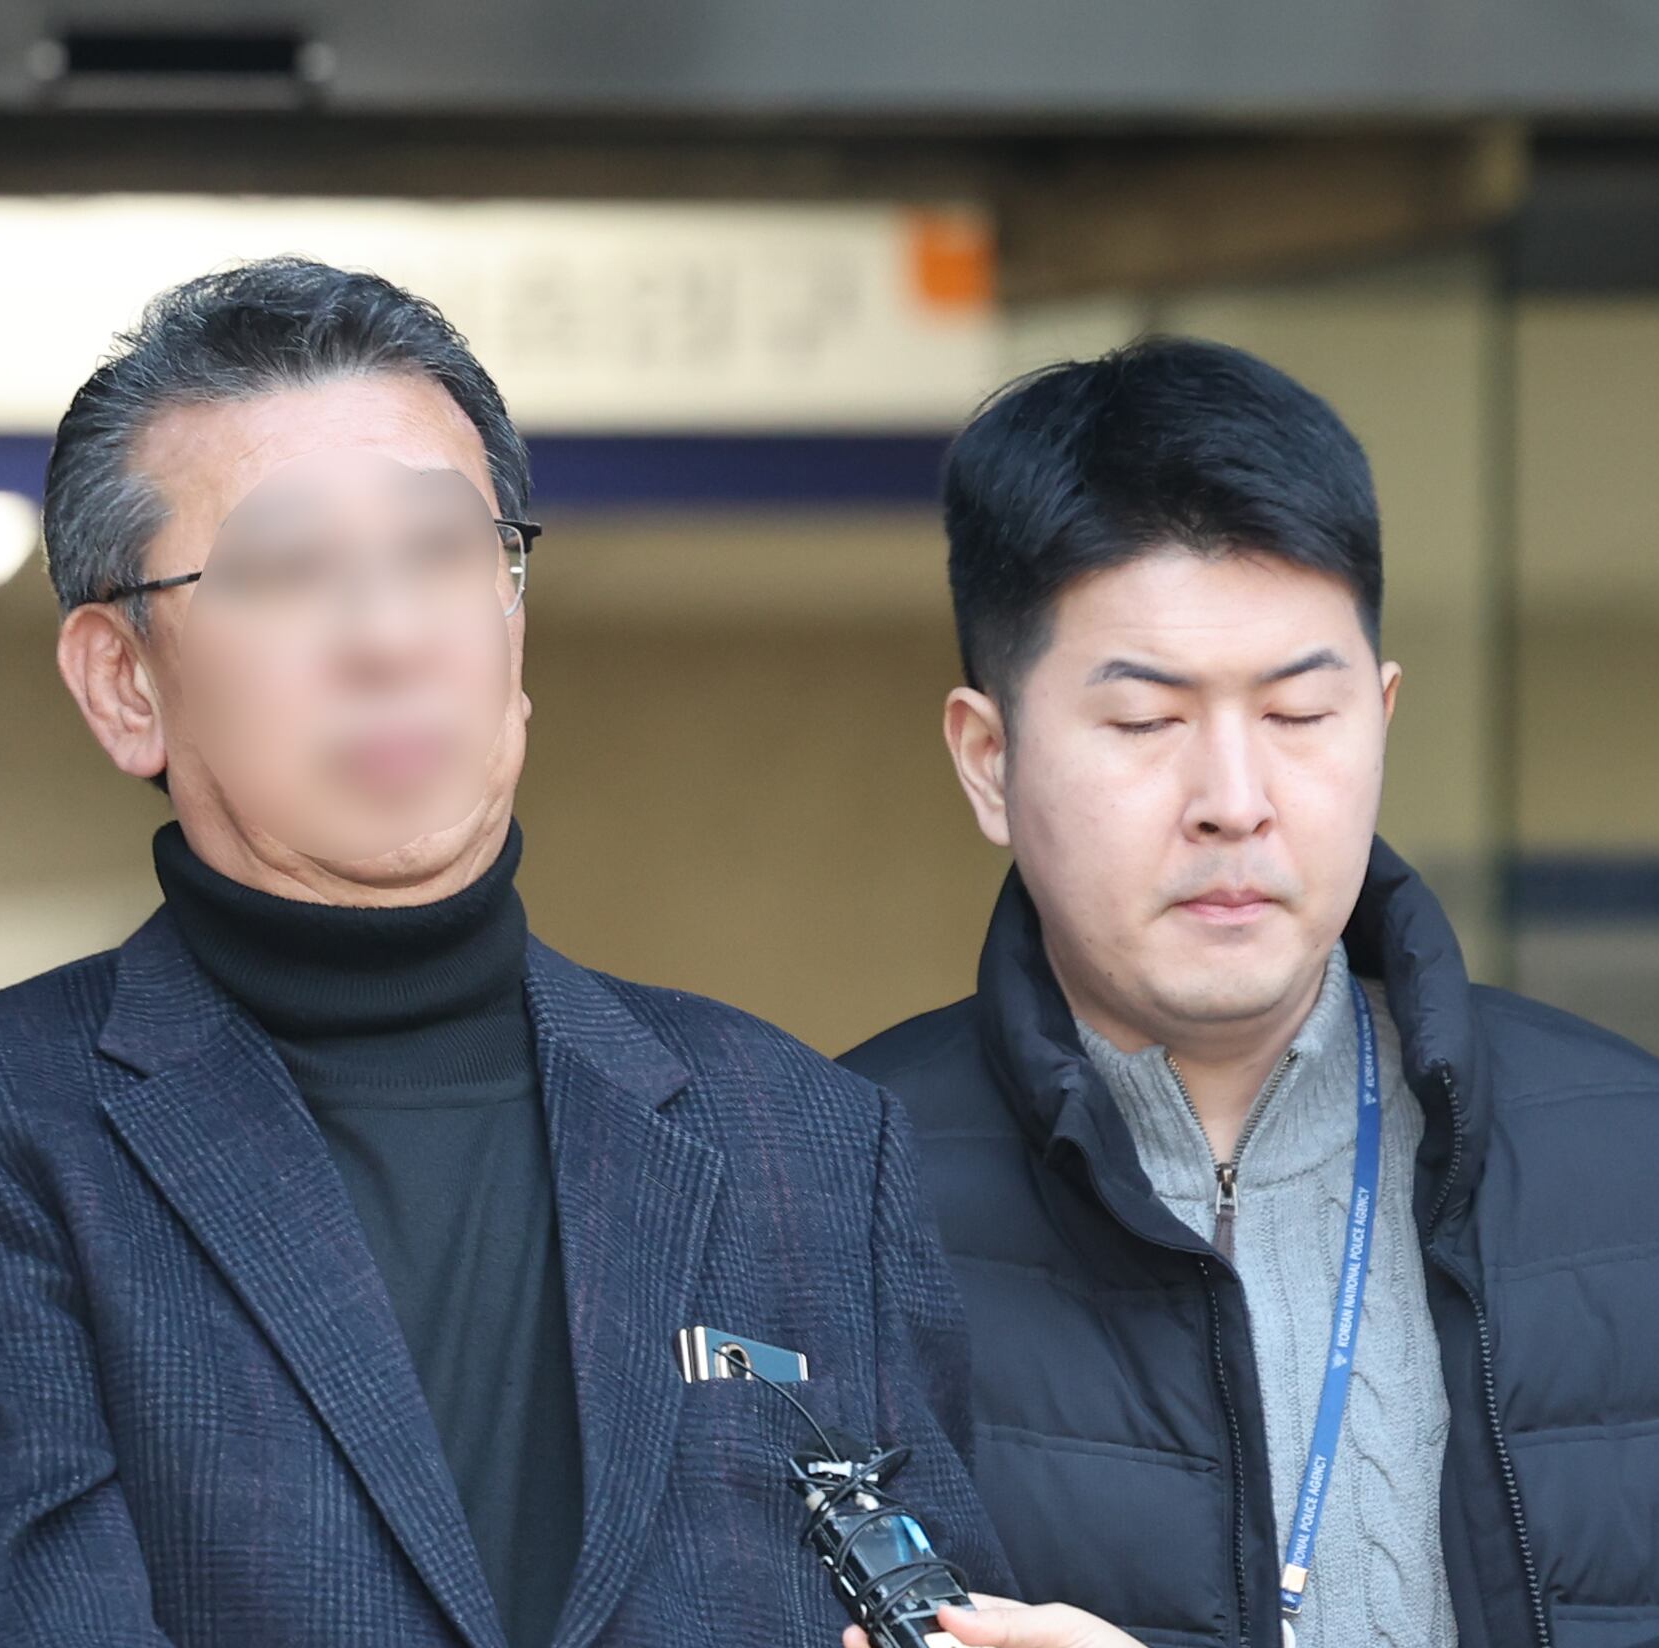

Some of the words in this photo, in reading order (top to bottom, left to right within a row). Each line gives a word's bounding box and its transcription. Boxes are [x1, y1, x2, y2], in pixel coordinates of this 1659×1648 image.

[1354, 1186, 1370, 1227] AGENCY
[1349, 1228, 1366, 1261] POLICE
[1343, 1261, 1362, 1311] NATIONAL
[1337, 1308, 1354, 1347] KOREAN
[1308, 1454, 1327, 1497] AGENCY
[1300, 1496, 1318, 1533] POLICE
